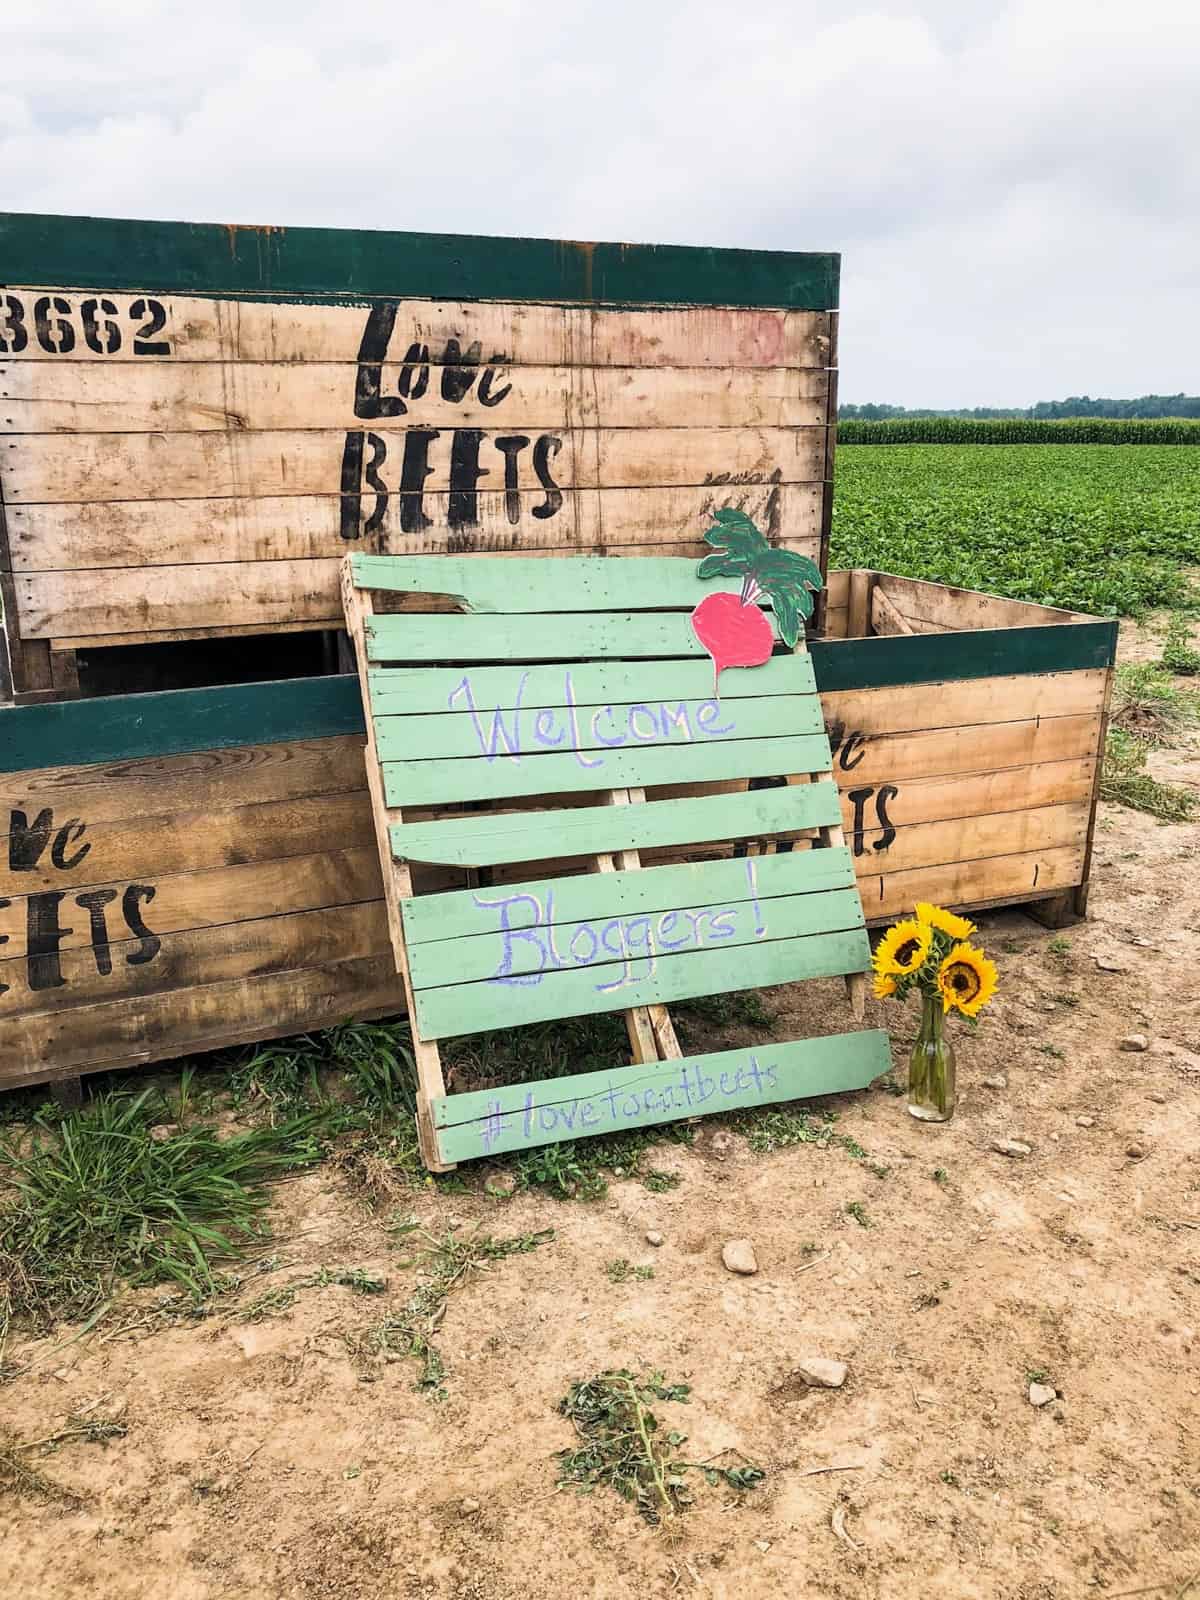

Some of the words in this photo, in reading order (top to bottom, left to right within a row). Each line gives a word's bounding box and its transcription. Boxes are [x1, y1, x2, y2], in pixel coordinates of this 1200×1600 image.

[0, 295, 170, 355] 3662
[354, 302, 513, 419] Love
[340, 431, 563, 540] BEETS
[448, 671, 736, 767] Welcome
[472, 860, 767, 992] Bloggers!
